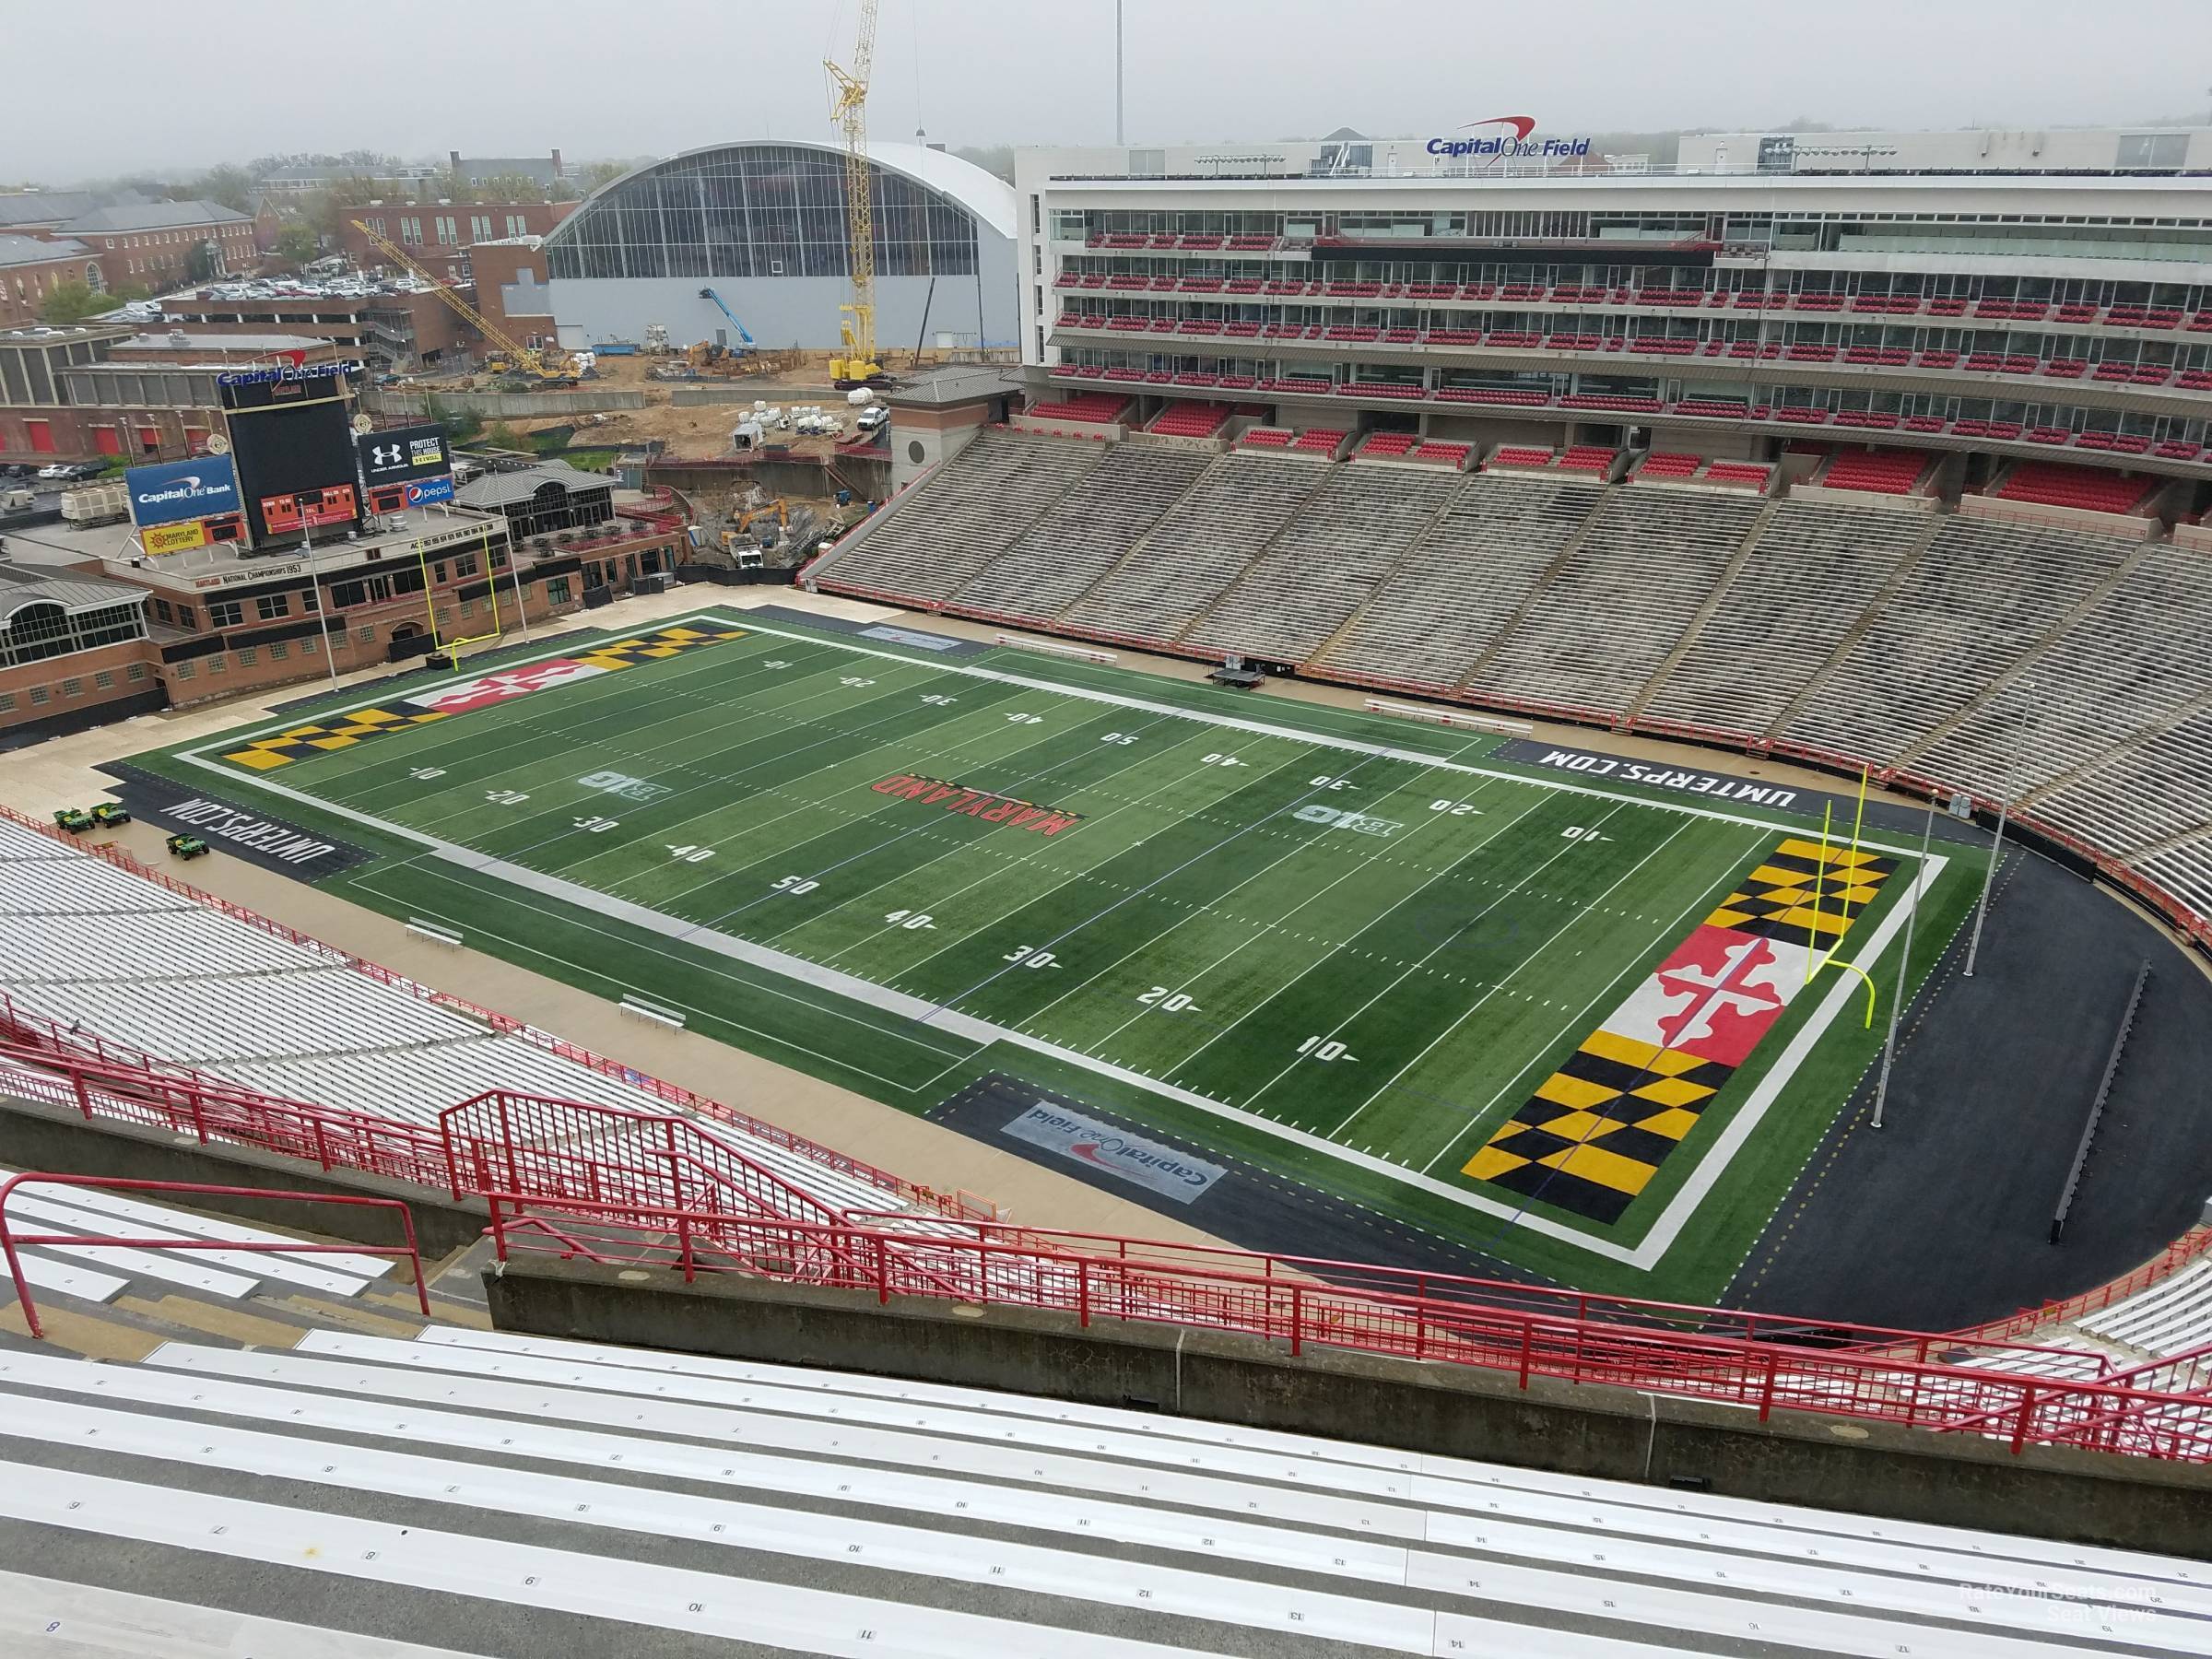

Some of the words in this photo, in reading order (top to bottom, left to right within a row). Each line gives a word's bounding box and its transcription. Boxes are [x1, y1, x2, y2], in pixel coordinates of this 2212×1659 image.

[1542, 138, 1590, 156] Field
[409, 437, 440, 450] PROTECT
[206, 484, 231, 495] Bank
[424, 483, 452, 499] pepsi
[165, 528, 199, 540] MARYLAND
[167, 536, 194, 546] LOTTERY
[1537, 750, 1798, 807] UMTERPS.COM
[871, 773, 1078, 837] MARYLAND
[159, 798, 335, 864] UMTERPS.COM
[670, 845, 716, 863] 40
[770, 875, 820, 895] 50
[884, 910, 934, 930] 40
[1003, 945, 1056, 969] 30
[1135, 986, 1194, 1012] 20
[1296, 1035, 1347, 1062] 10
[1026, 1109, 1080, 1135] Field
[848, 1545, 860, 1553] 10
[993, 1566, 1001, 1574] 11
[1138, 1590, 1149, 1598] 12
[688, 1603, 702, 1612] 10
[1290, 1612, 1301, 1620] 13
[1748, 1622, 1759, 1630] 16
[861, 1630, 872, 1640] 11
[1451, 1640, 1463, 1649] 14
[1899, 1645, 1910, 1653] 17
